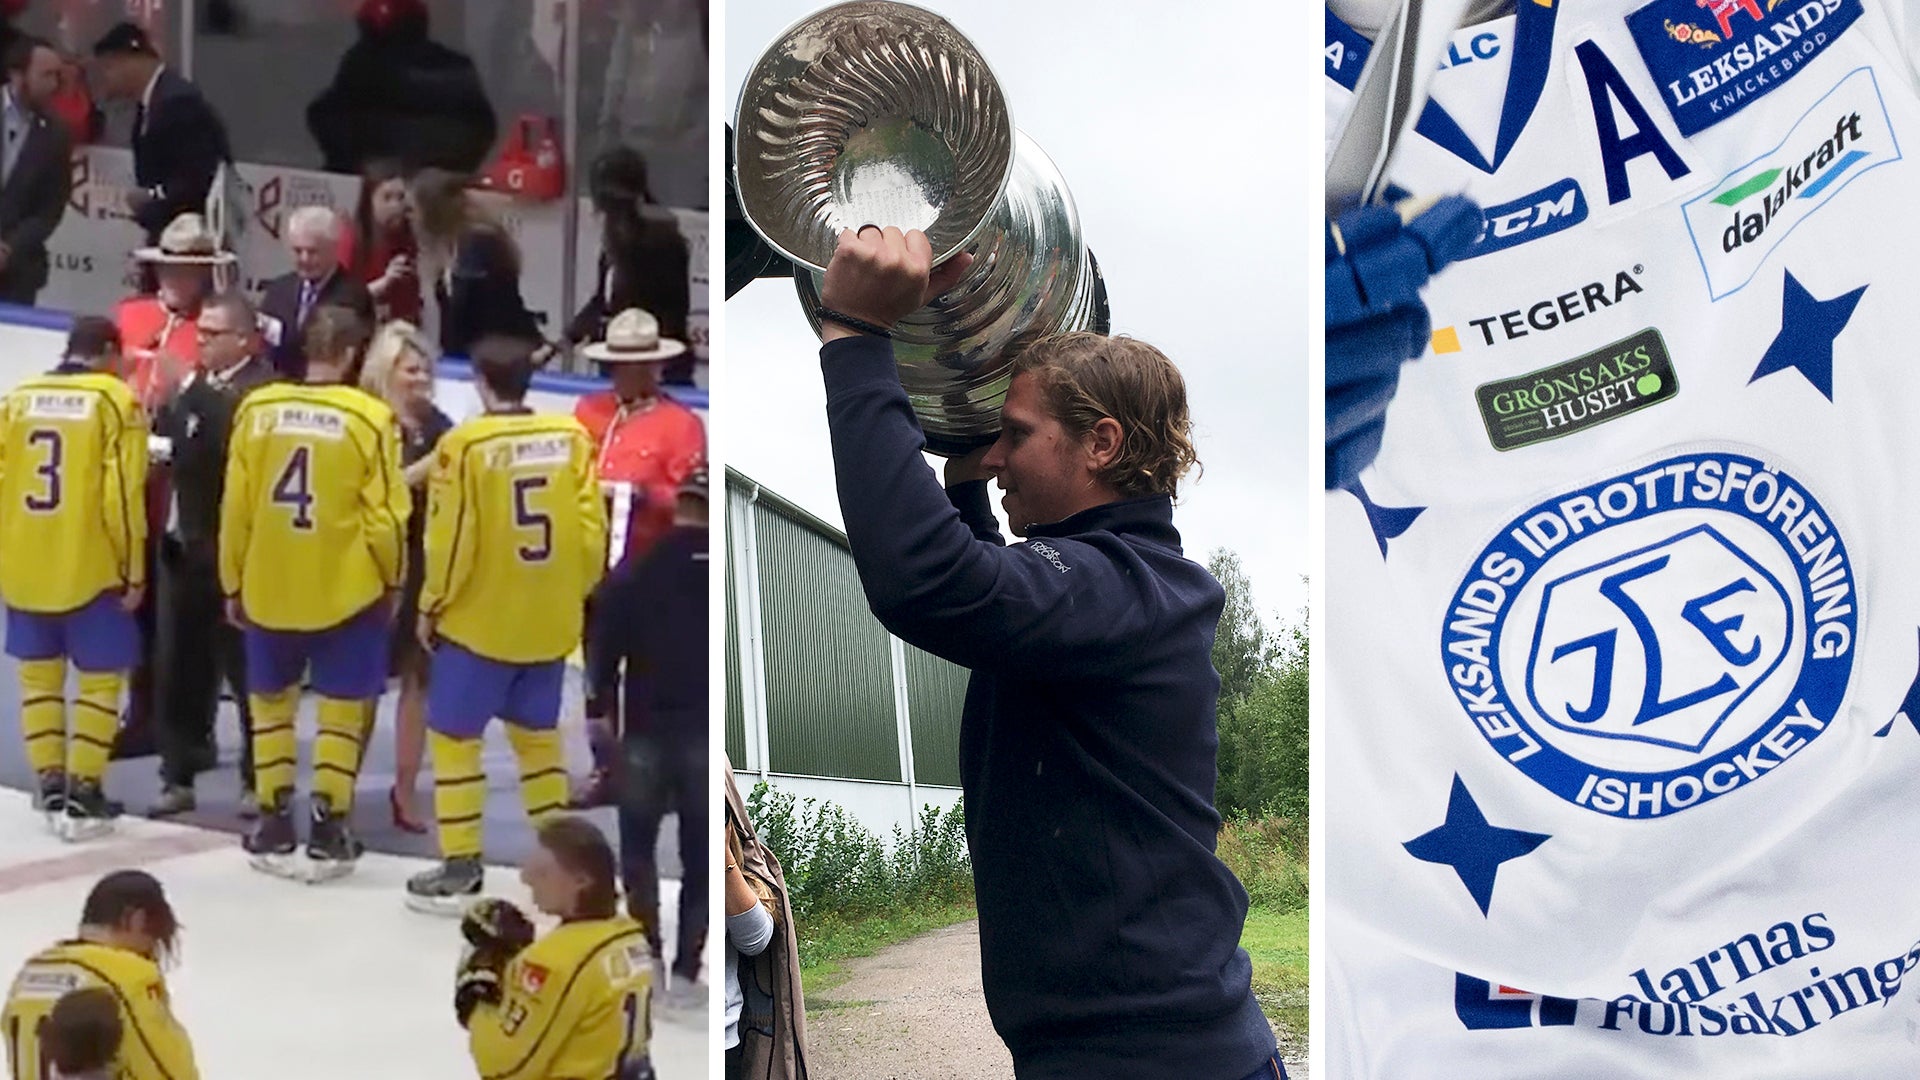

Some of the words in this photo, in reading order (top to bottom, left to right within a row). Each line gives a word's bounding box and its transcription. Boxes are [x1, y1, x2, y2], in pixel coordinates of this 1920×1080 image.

[1437, 32, 1501, 71] LC
[1668, 0, 1843, 107] LEKSANDS
[1709, 31, 1828, 113] KNÄCKEBRÖD
[1574, 38, 1691, 206] A
[1722, 111, 1863, 253] dalakraft
[1492, 345, 1652, 415] GRÖNSAKS
[1540, 376, 1637, 430] HUSET
[25, 429, 62, 511] 3
[272, 446, 313, 530] 4
[514, 477, 552, 561] 5
[1448, 551, 1543, 763] LEKSANDS
[1511, 459, 1854, 661] IDROTTSFÖRENING
[1575, 698, 1826, 817] ISHOCKEY
